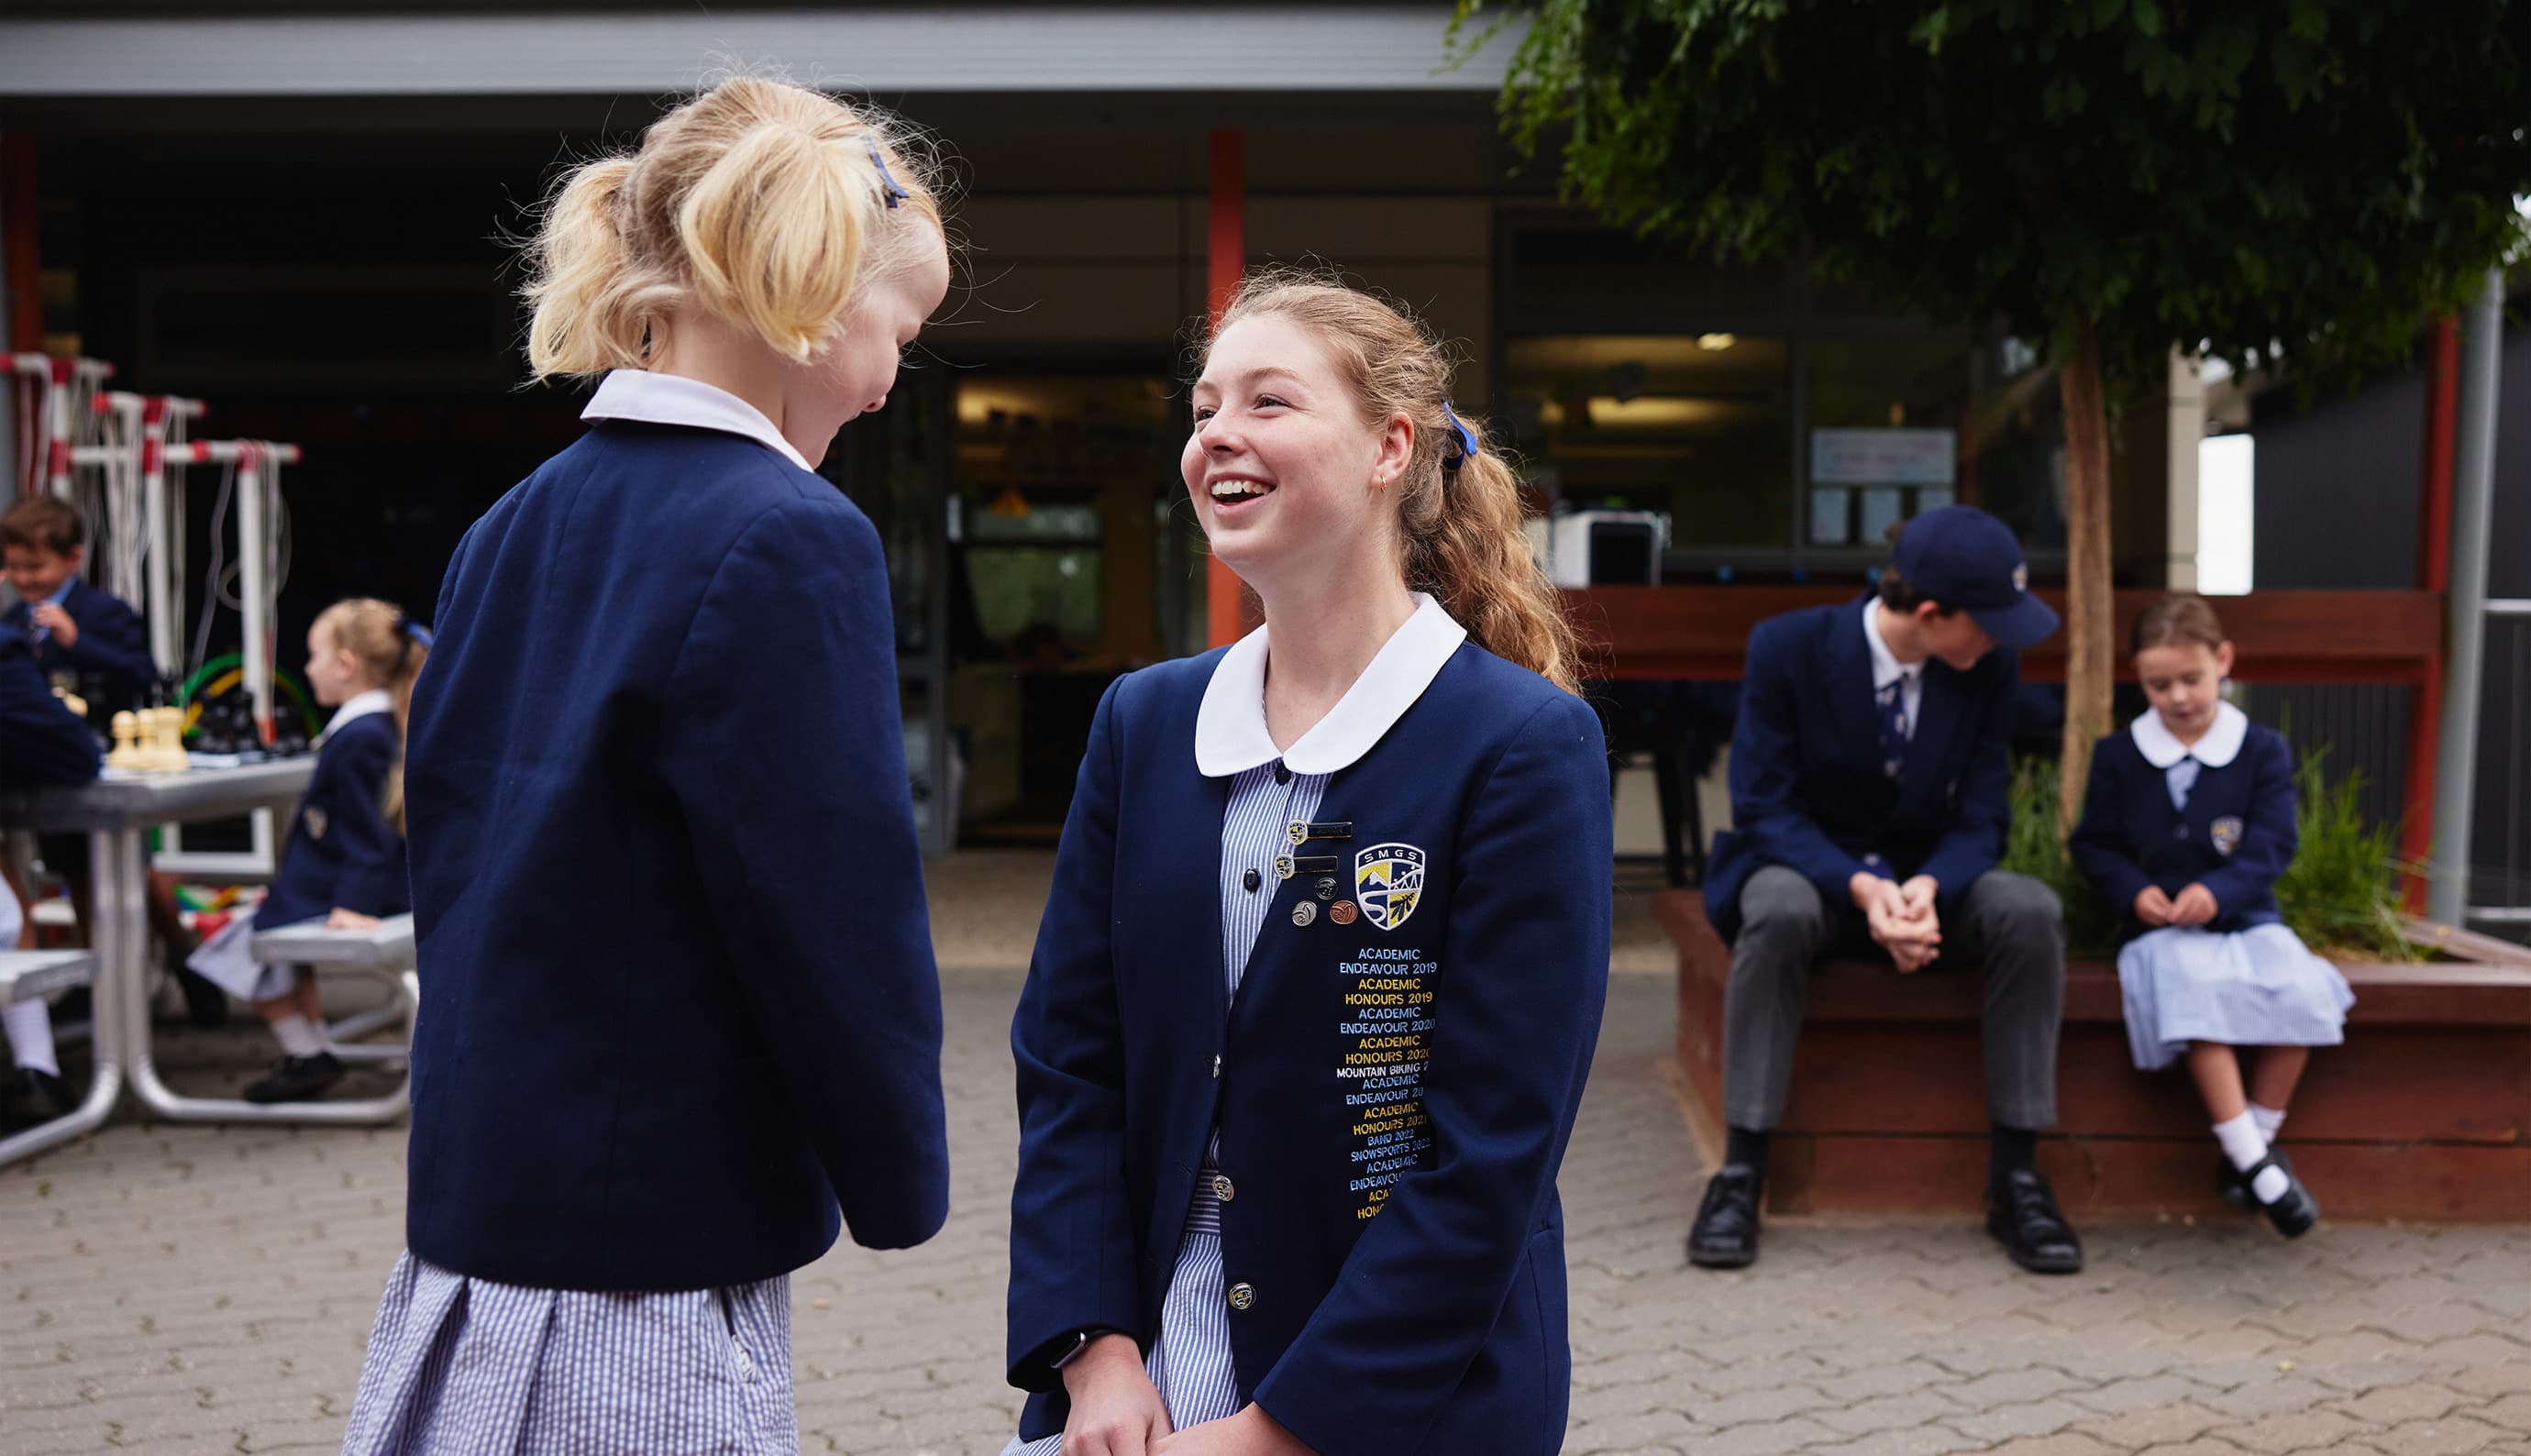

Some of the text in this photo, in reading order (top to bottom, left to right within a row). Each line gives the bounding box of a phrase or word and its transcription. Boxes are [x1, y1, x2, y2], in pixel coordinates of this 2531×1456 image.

[1364, 849, 1418, 863] SMGS
[1358, 948, 1420, 960] ACADEMIC
[1340, 962, 1437, 975] ENDEAVOUR 2019
[1358, 978, 1421, 990] ACADEMIC
[1345, 992, 1432, 1005] HONOURS 2019
[1359, 1007, 1421, 1020] ACADEMIC
[1341, 1019, 1436, 1034] ENDEAVOUR 2020
[1359, 1035, 1420, 1049] ACADEMIC
[1345, 1051, 1403, 1064] HONOURS
[1336, 1066, 1387, 1078] MOUNTAIN
[1389, 1063, 1420, 1075] BIKING
[1363, 1074, 1420, 1089] ACADEMIC
[1345, 1089, 1409, 1105] ENDEAVOUR
[1365, 1102, 1419, 1120] ACADEMIC
[1353, 1119, 1403, 1136] HONOURS
[1367, 1129, 1415, 1146] BAND 2022
[1351, 1138, 1431, 1162] SNOWSPORTS 2022
[1366, 1154, 1419, 1174] ACADEMIC
[1350, 1171, 1406, 1191] ENDEAVOU
